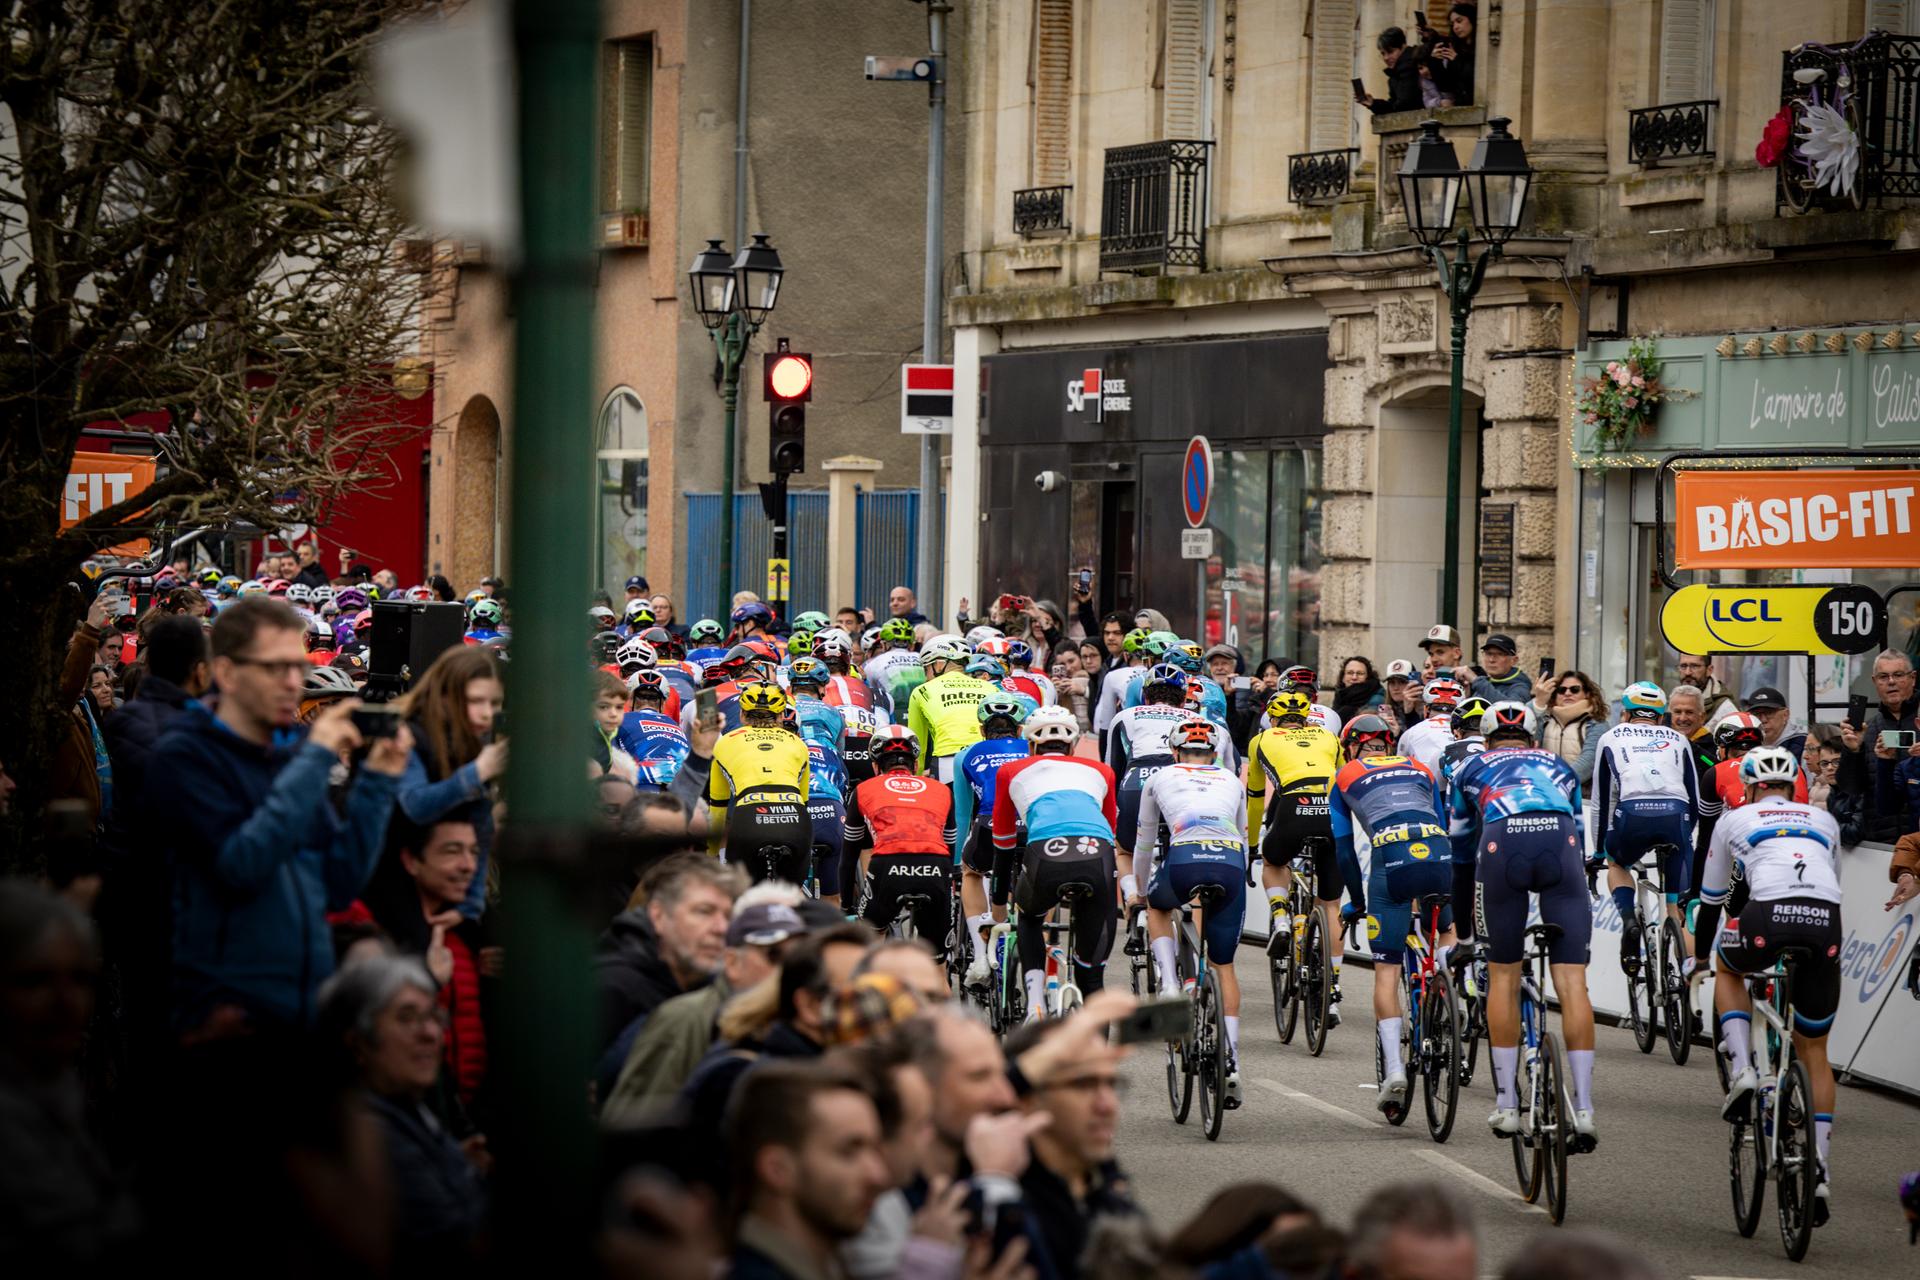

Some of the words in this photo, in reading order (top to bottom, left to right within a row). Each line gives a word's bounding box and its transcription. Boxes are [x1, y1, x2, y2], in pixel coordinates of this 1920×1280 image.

[1826, 367, 1847, 425] de
[1696, 487, 1915, 552] BASIC-FIT
[1712, 598, 1783, 622] LCL
[1828, 601, 1874, 636] 150
[858, 709, 877, 726] 66
[1613, 727, 1680, 738] BAHRAIN
[1361, 769, 1428, 785] TREK
[744, 793, 769, 803] LCL
[769, 805, 798, 813] VISMA
[763, 815, 800, 824] BETCITY
[1507, 817, 1559, 826] RENSON
[1506, 824, 1559, 833] OUTDOOR
[888, 865, 942, 877] ARKEA
[1476, 883, 1487, 936] SOUDAL
[1773, 904, 1830, 918] RENSON
[1772, 915, 1830, 927] OUTDOOR
